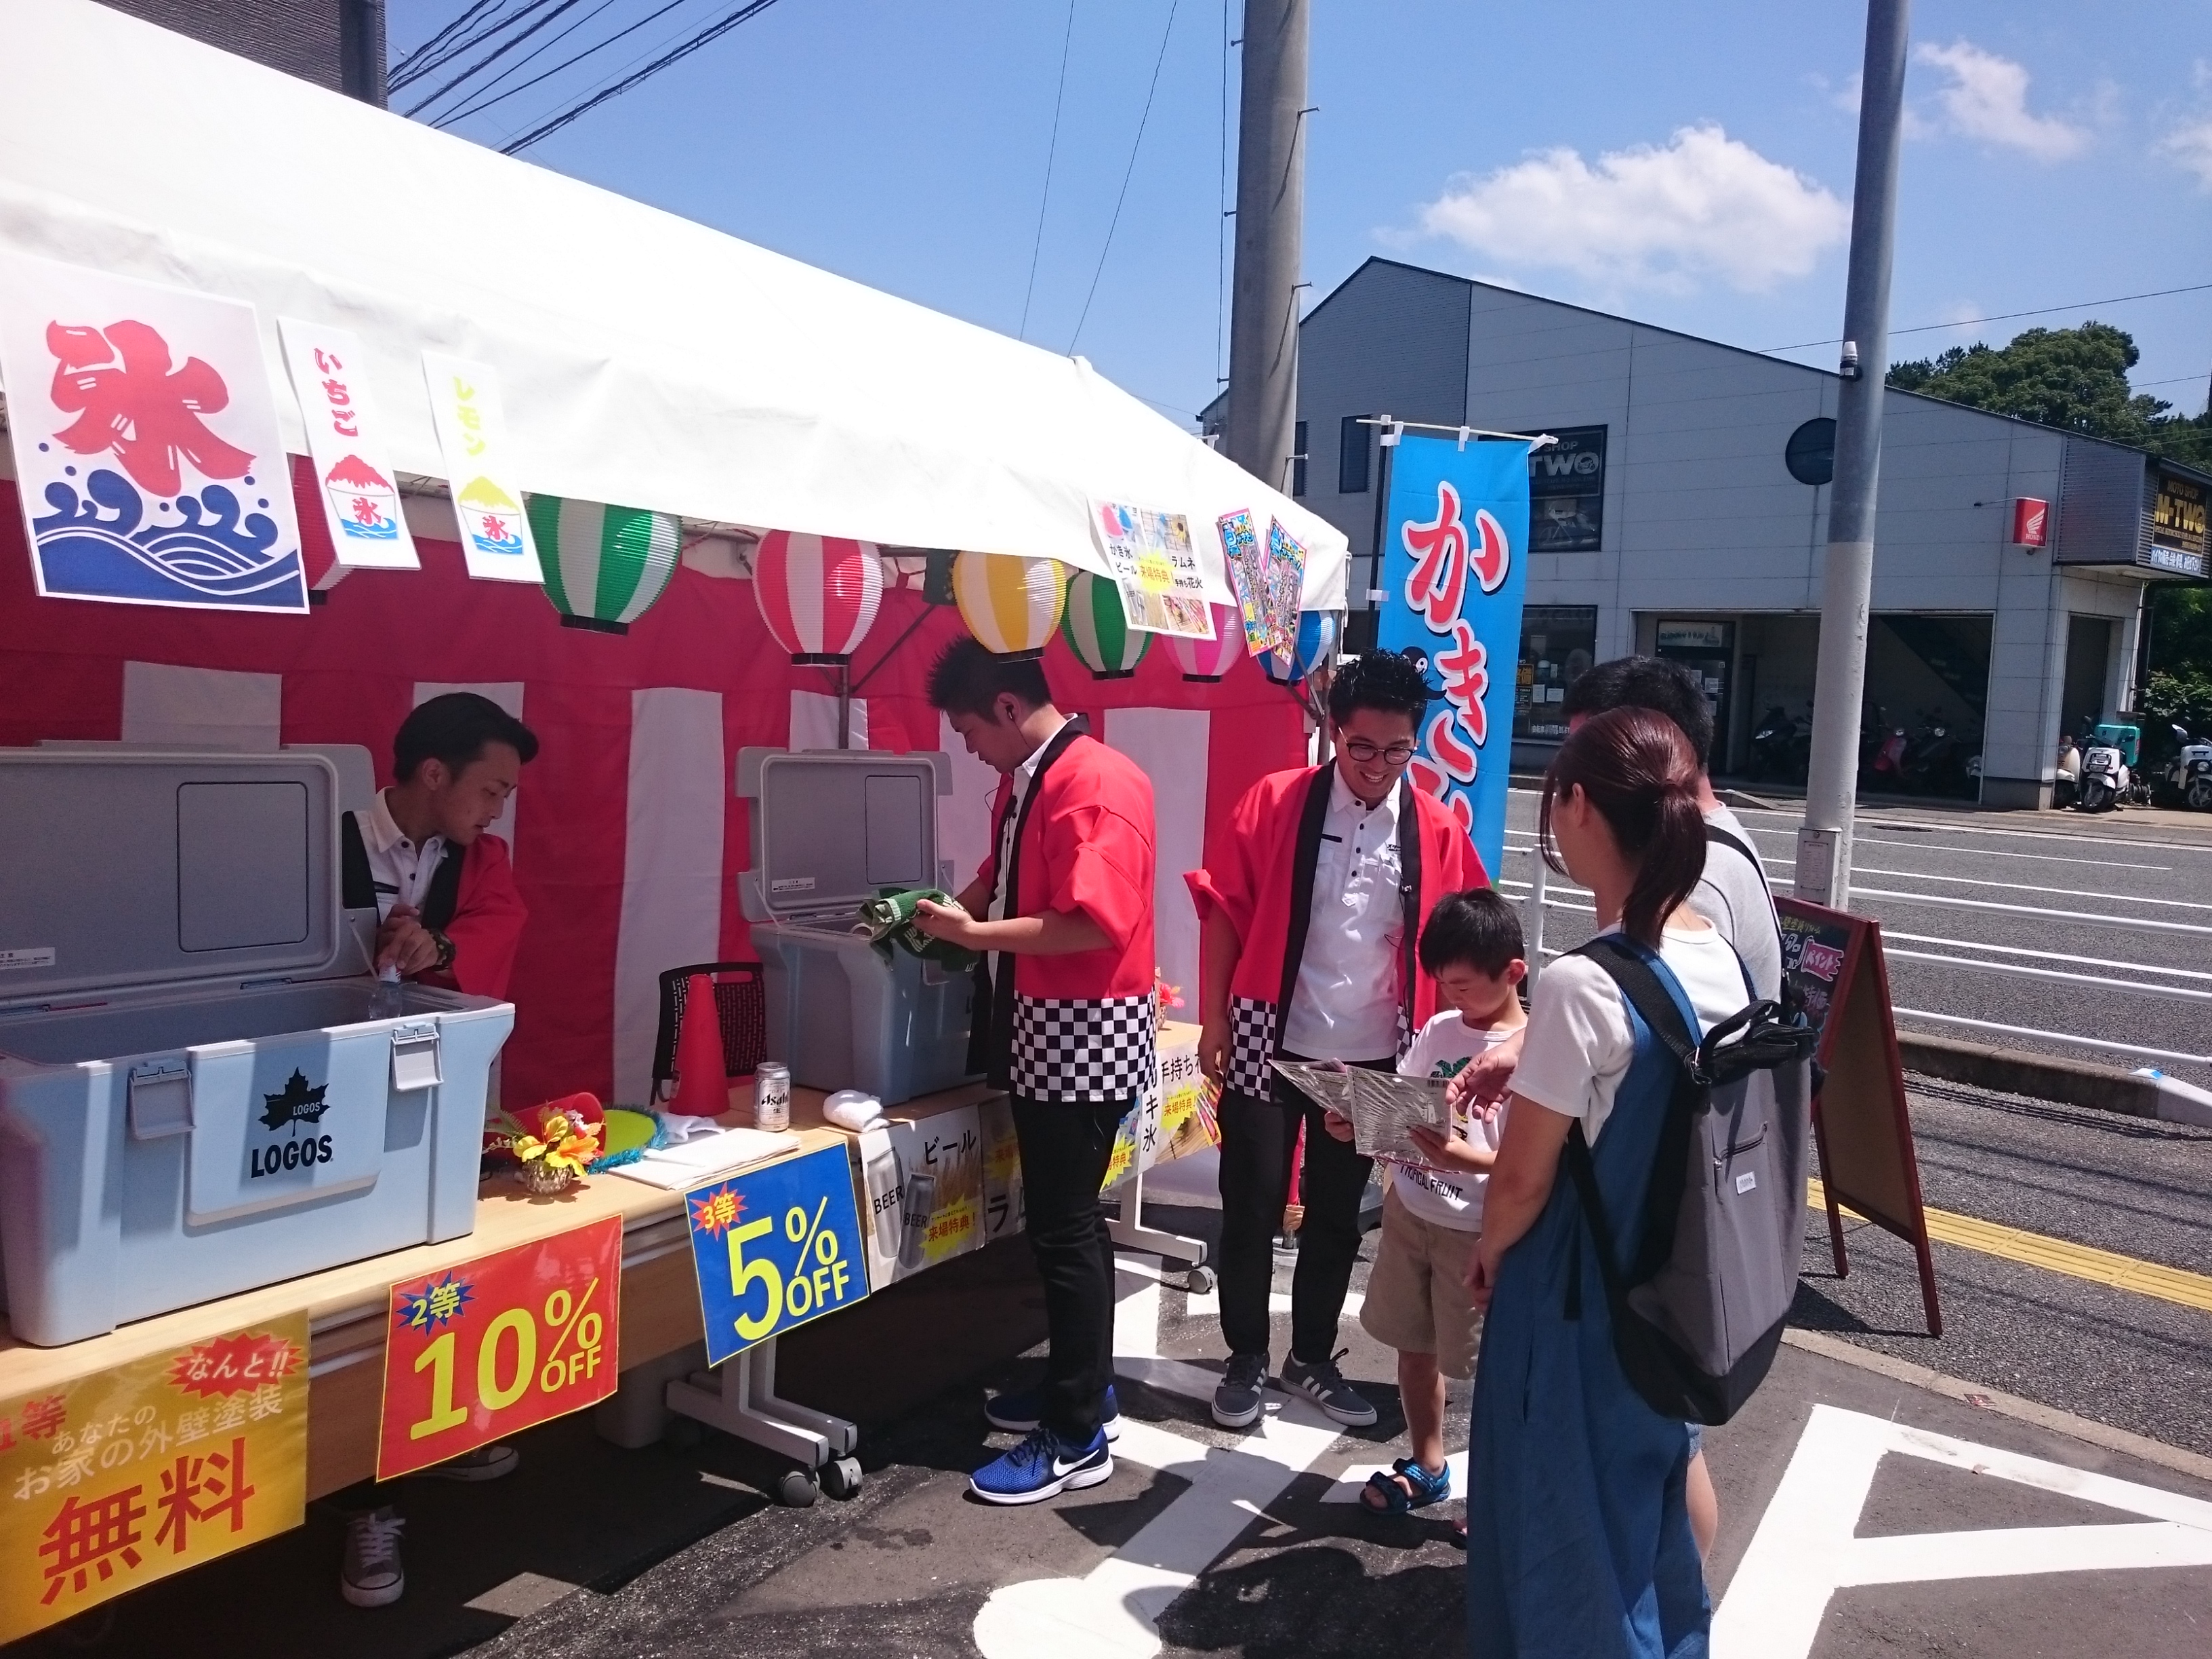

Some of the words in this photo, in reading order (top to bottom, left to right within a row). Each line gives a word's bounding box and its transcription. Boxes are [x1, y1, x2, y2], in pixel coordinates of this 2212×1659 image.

[45, 319, 257, 498] 氷
[314, 348, 359, 436] いちご
[453, 375, 486, 456] レモン
[1529, 451, 1600, 478] TWO
[1546, 441, 1579, 453] SHOP
[352, 497, 382, 525] 氷
[482, 515, 509, 540] 氷
[2155, 493, 2205, 534] M-TWO
[1109, 544, 1133, 559] かき氷
[2025, 533, 2043, 541] HONDA
[1115, 562, 1137, 575] ビール
[1171, 556, 1195, 570] ラムネ
[1174, 576, 1204, 589] 手持ち花火
[293, 1102, 321, 1116] LOGOS
[761, 1091, 789, 1106] Asahi
[251, 1134, 333, 1178] LOGOS
[924, 1130, 977, 1166] ビール
[874, 1185, 904, 1215] BEER
[1431, 1179, 1463, 1201] FRUIT
[703, 1193, 736, 1229] 3等
[904, 1212, 927, 1229] BEER
[727, 1196, 838, 1340] 5%
[411, 1282, 461, 1327] 2等
[786, 1259, 850, 1317] OFF
[410, 1277, 602, 1440] 10%
[540, 1345, 602, 1393] OFF
[13, 1384, 283, 1501] お家の外壁塗装
[52, 1404, 157, 1456] あなたの
[38, 1436, 256, 1606] 無料
